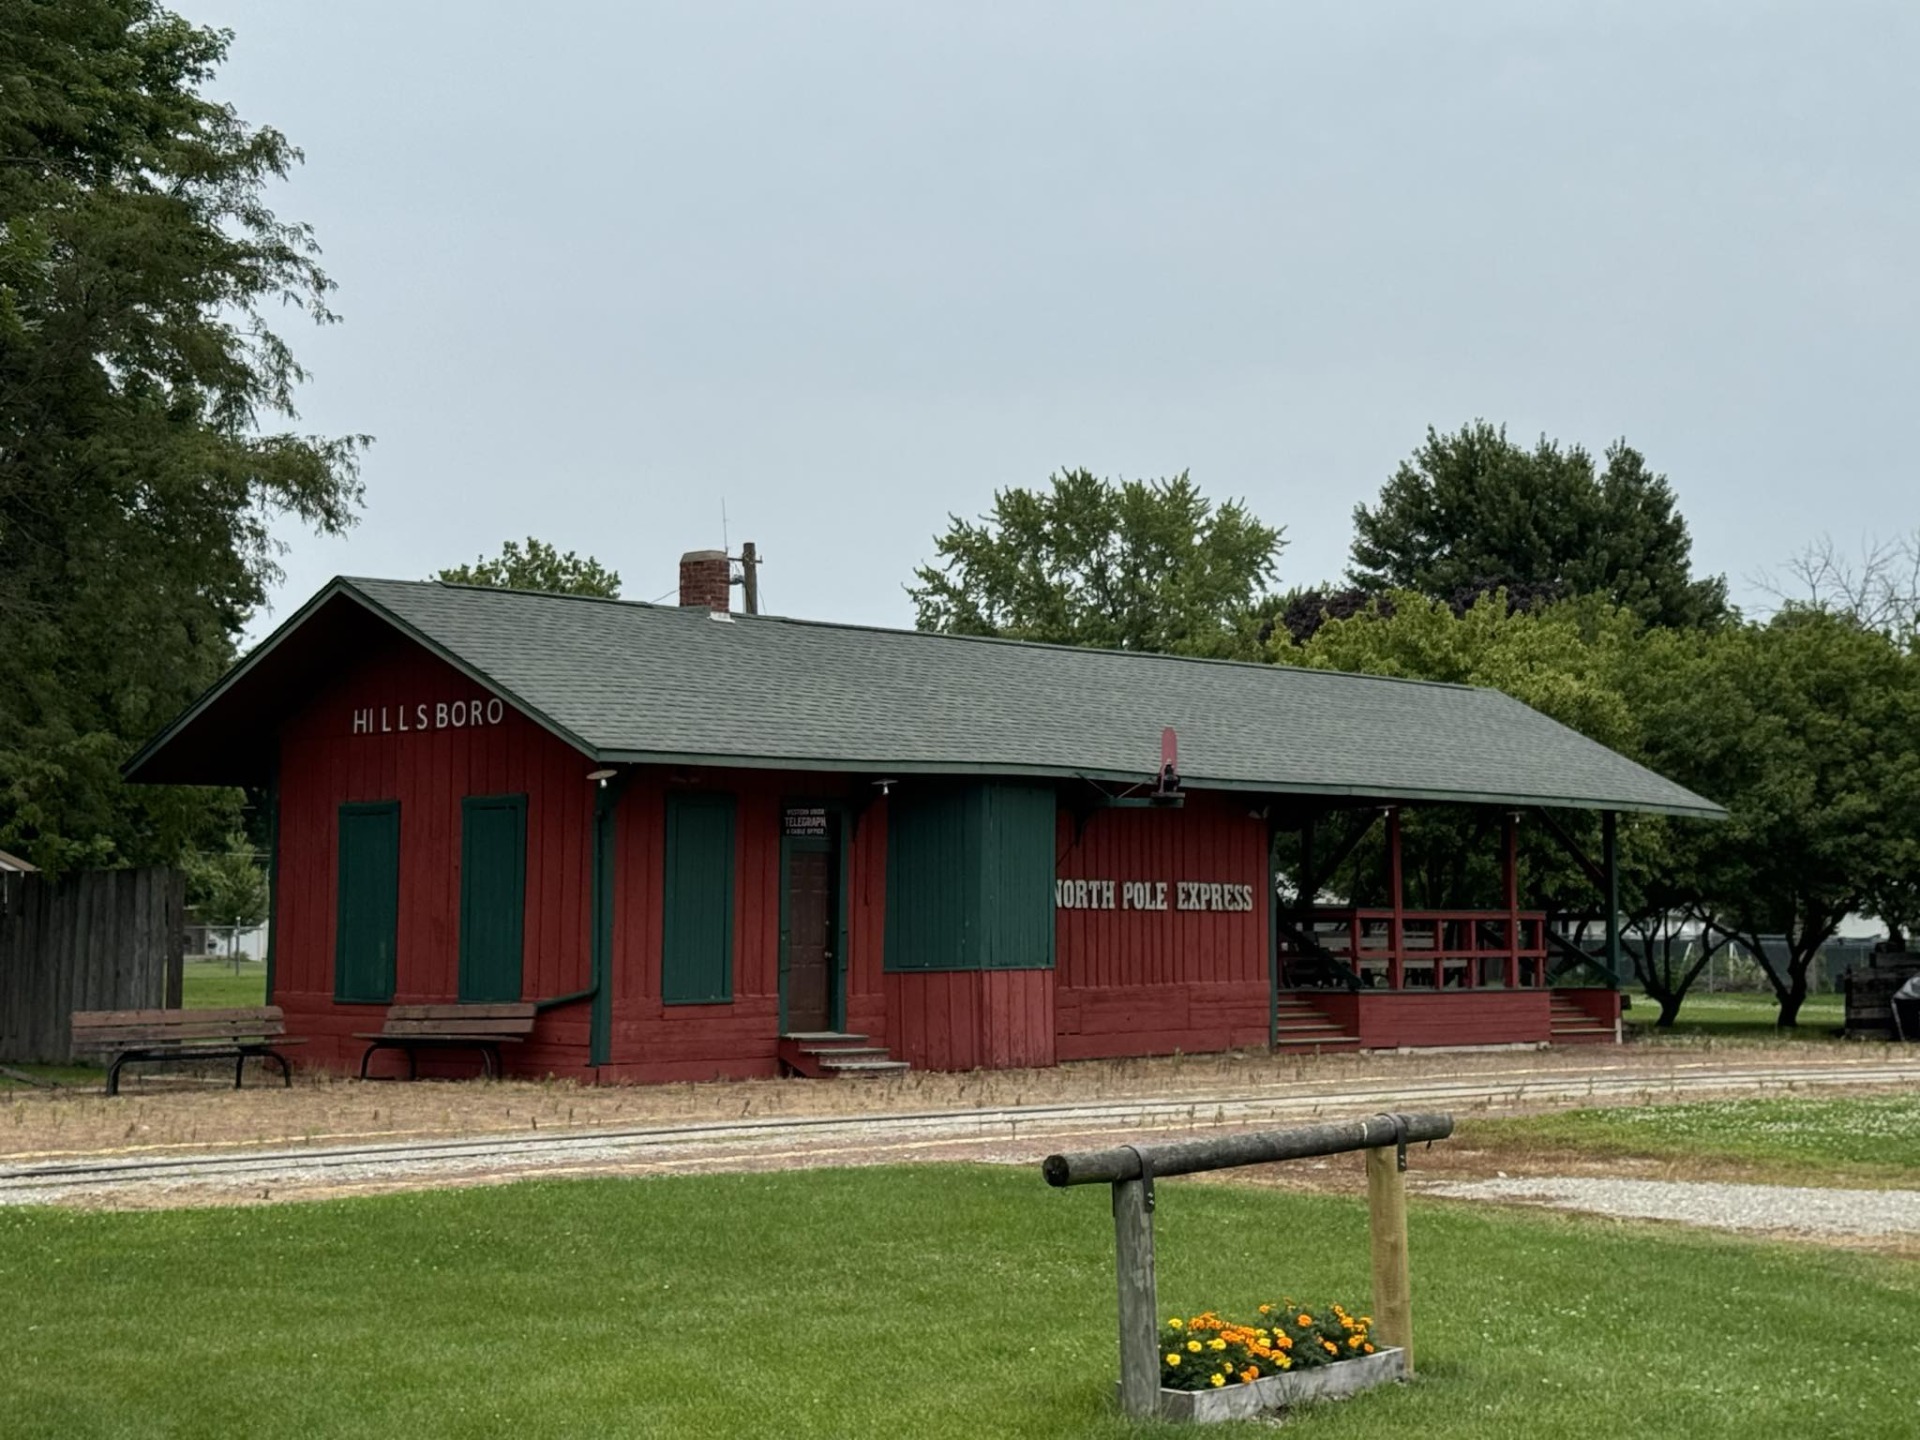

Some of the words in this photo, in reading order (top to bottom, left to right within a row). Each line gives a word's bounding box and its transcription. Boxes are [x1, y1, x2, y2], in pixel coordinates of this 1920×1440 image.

[353, 698, 504, 734] HILLSBORO
[784, 816, 826, 827] TELEGRAPH
[1123, 881, 1168, 910] POLE
[1177, 881, 1253, 911] EXPRESS
